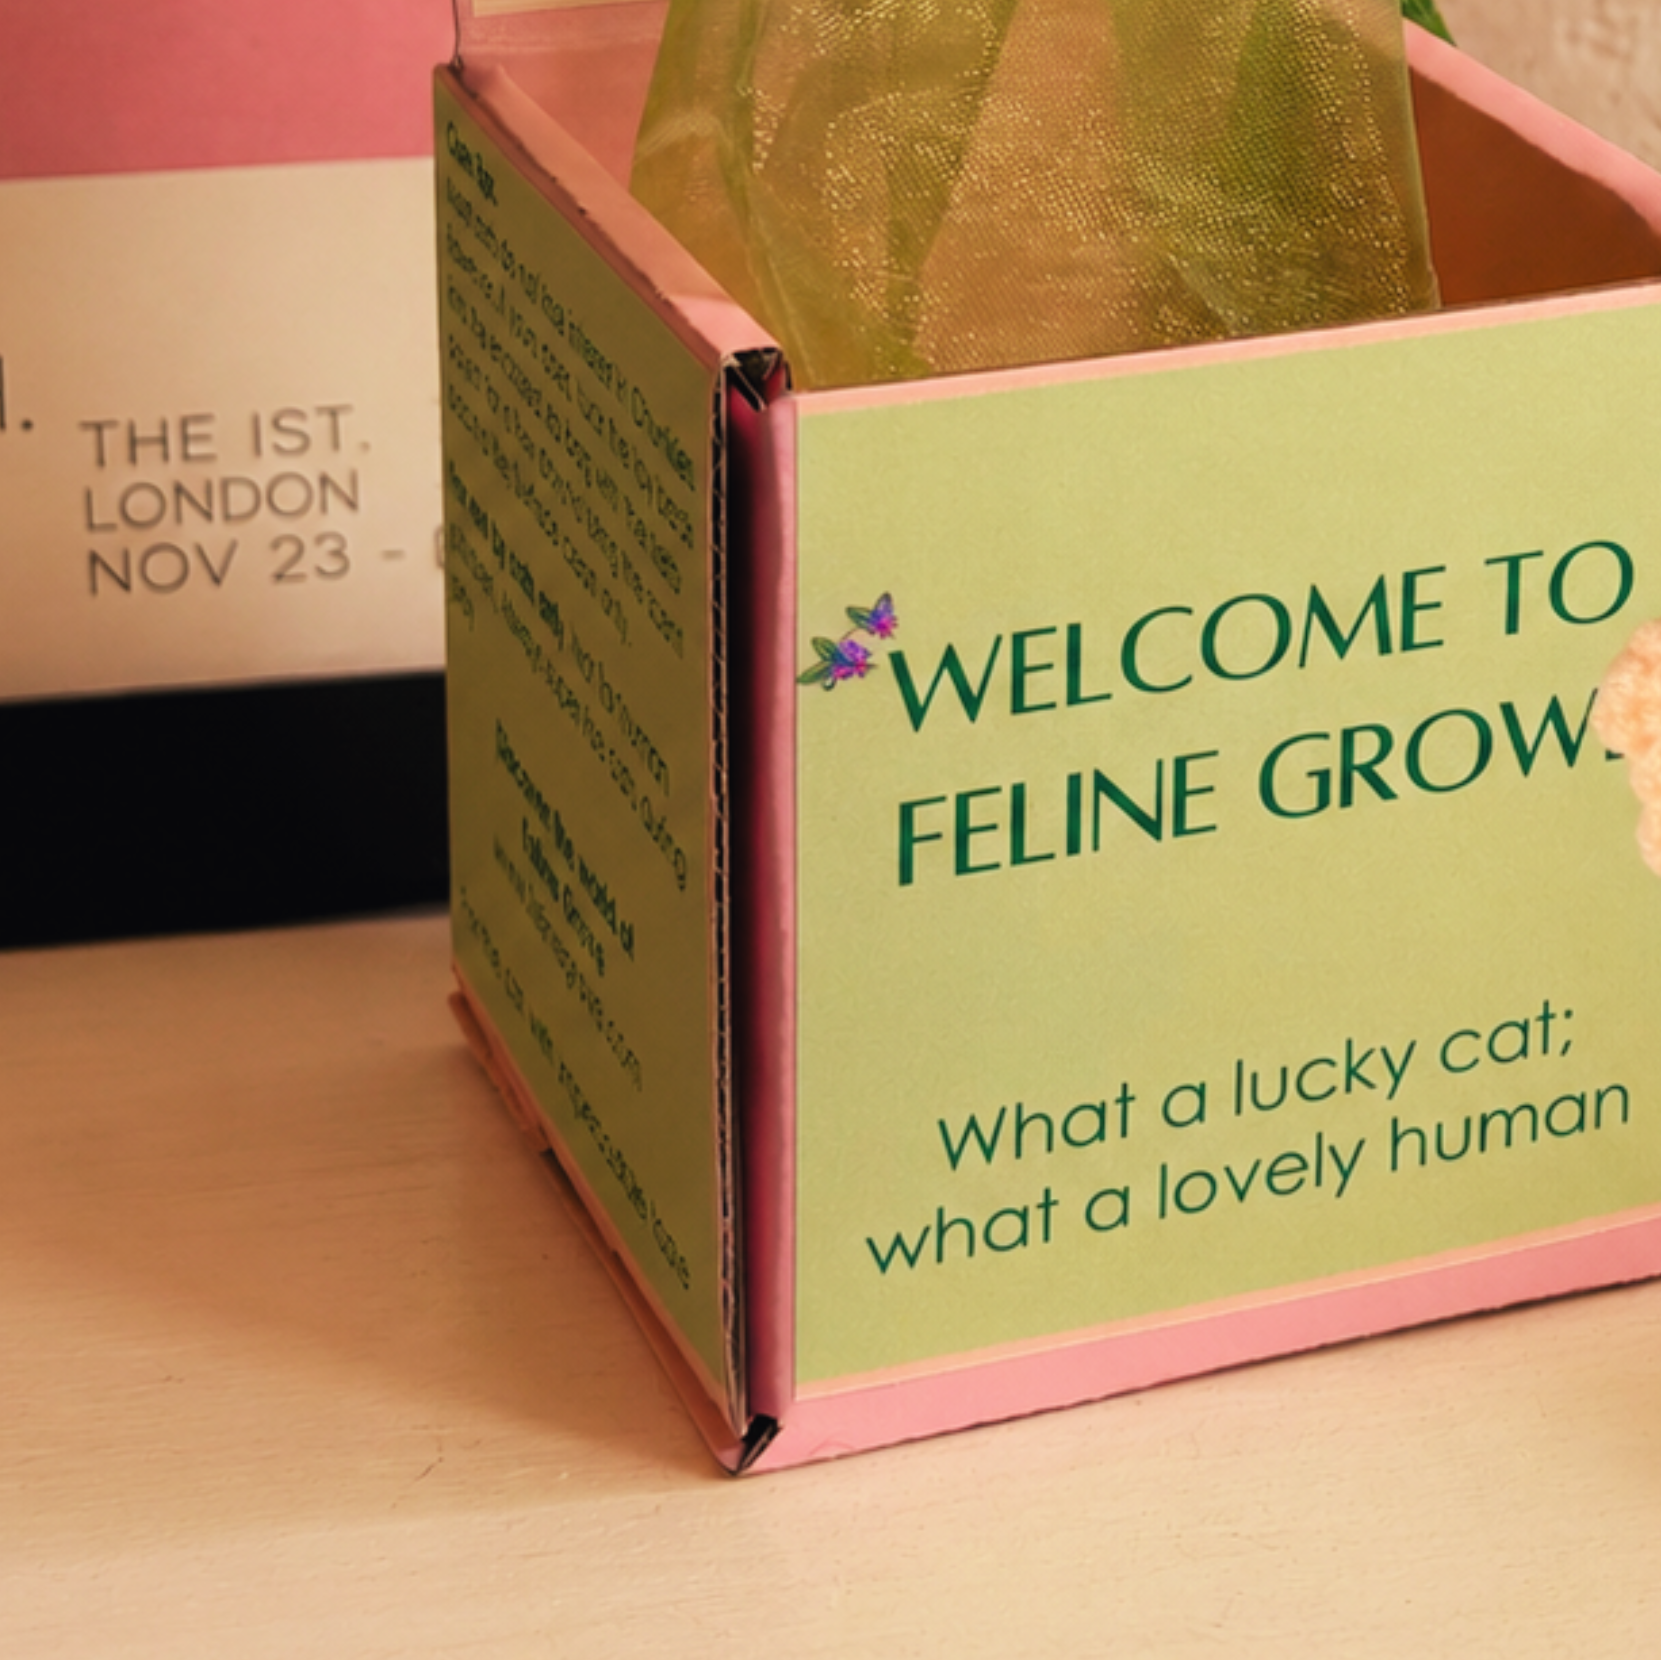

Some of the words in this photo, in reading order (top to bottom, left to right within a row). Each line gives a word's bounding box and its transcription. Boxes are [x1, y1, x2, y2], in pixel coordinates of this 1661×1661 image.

[79, 412, 218, 469] THE
[84, 469, 360, 532] LONDON
[88, 539, 239, 597] NOV
[270, 531, 351, 585] 23
[889, 565, 1447, 732] WELCOME
[1485, 539, 1635, 637] TO
[897, 748, 1219, 887] FELINE
[1258, 686, 1626, 819] GROW
[938, 1082, 1137, 1171] What
[1161, 1081, 1208, 1128] a
[1232, 1038, 1417, 1118] lucky
[1439, 999, 1575, 1074] cat;
[866, 1186, 1060, 1274] what
[1083, 1185, 1131, 1232] a
[1156, 1129, 1367, 1220] lovely
[1389, 1082, 1630, 1171] human
